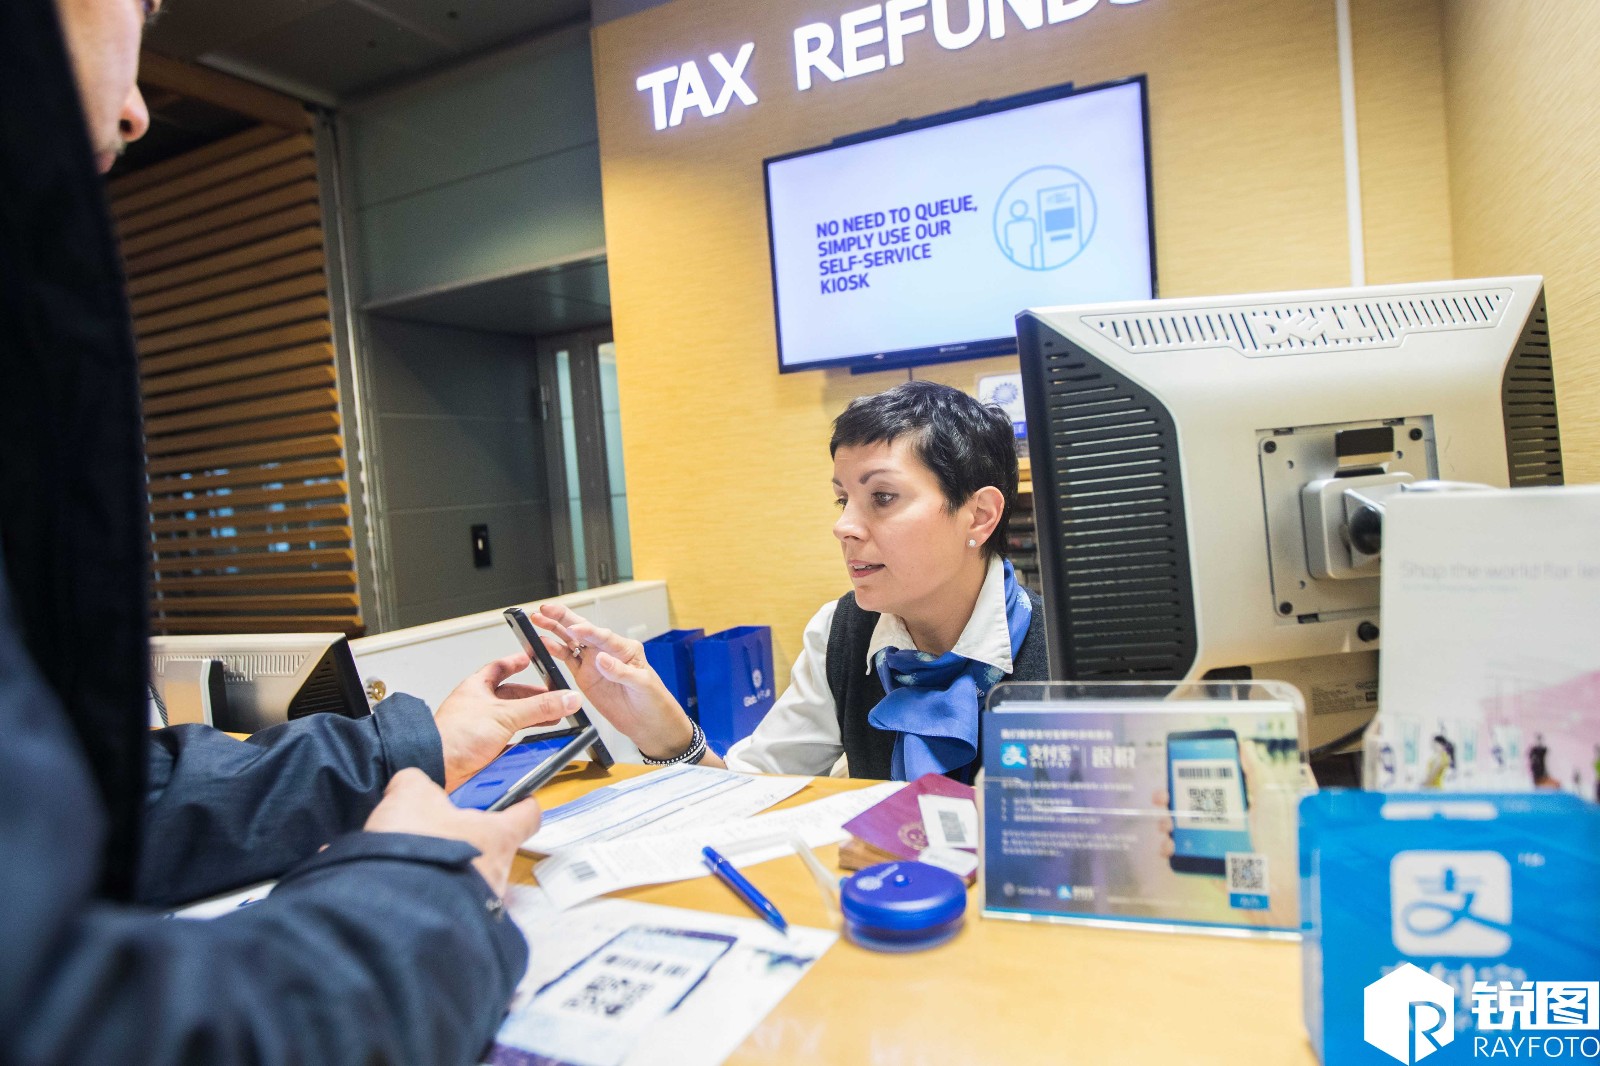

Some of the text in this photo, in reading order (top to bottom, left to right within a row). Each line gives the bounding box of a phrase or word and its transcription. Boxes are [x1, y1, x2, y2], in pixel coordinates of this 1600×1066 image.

[636, 0, 1146, 131] TAX REFUN
[816, 194, 978, 238] NO NEED TO QUEUE,
[818, 220, 951, 257] SIMPLY USE OUR
[819, 243, 932, 276] SELF-SERVICE
[820, 273, 870, 294] KIOSK
[1252, 309, 1376, 346] DELL
